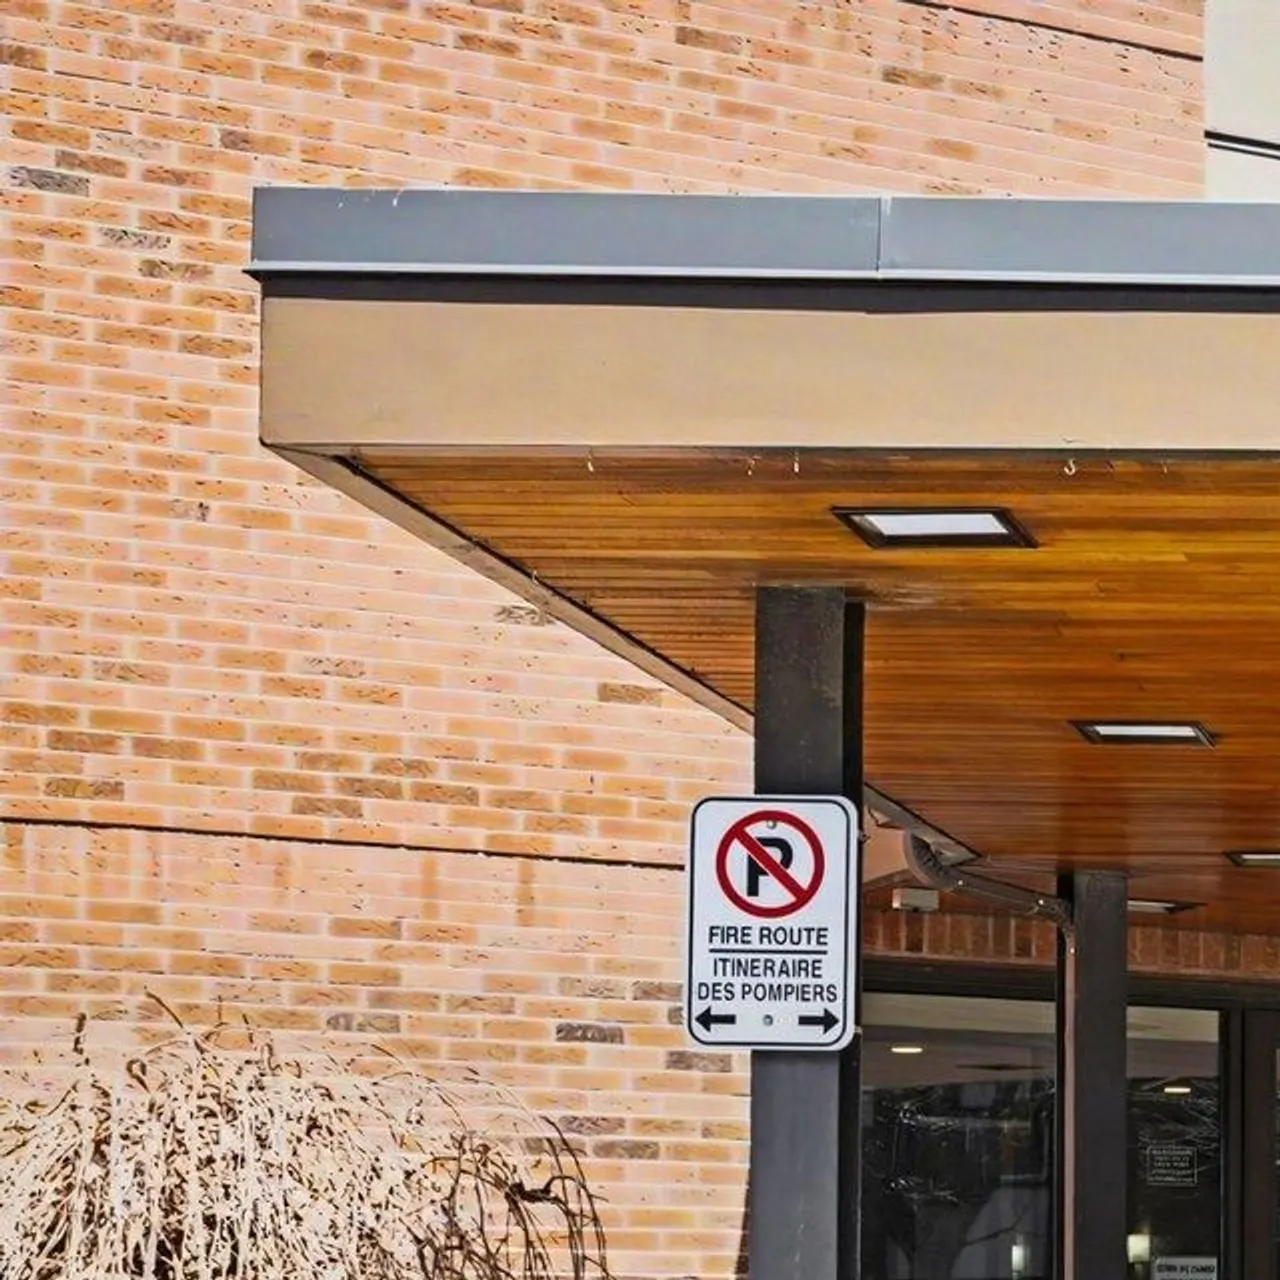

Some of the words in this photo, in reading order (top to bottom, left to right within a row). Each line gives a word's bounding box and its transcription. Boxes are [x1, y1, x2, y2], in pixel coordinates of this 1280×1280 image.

[708, 925, 752, 945] FIRE
[759, 926, 829, 946] ROUTE
[713, 958, 823, 979] ITINERAIRE
[698, 982, 735, 1001] DES
[741, 983, 838, 1002] POMPIERS
